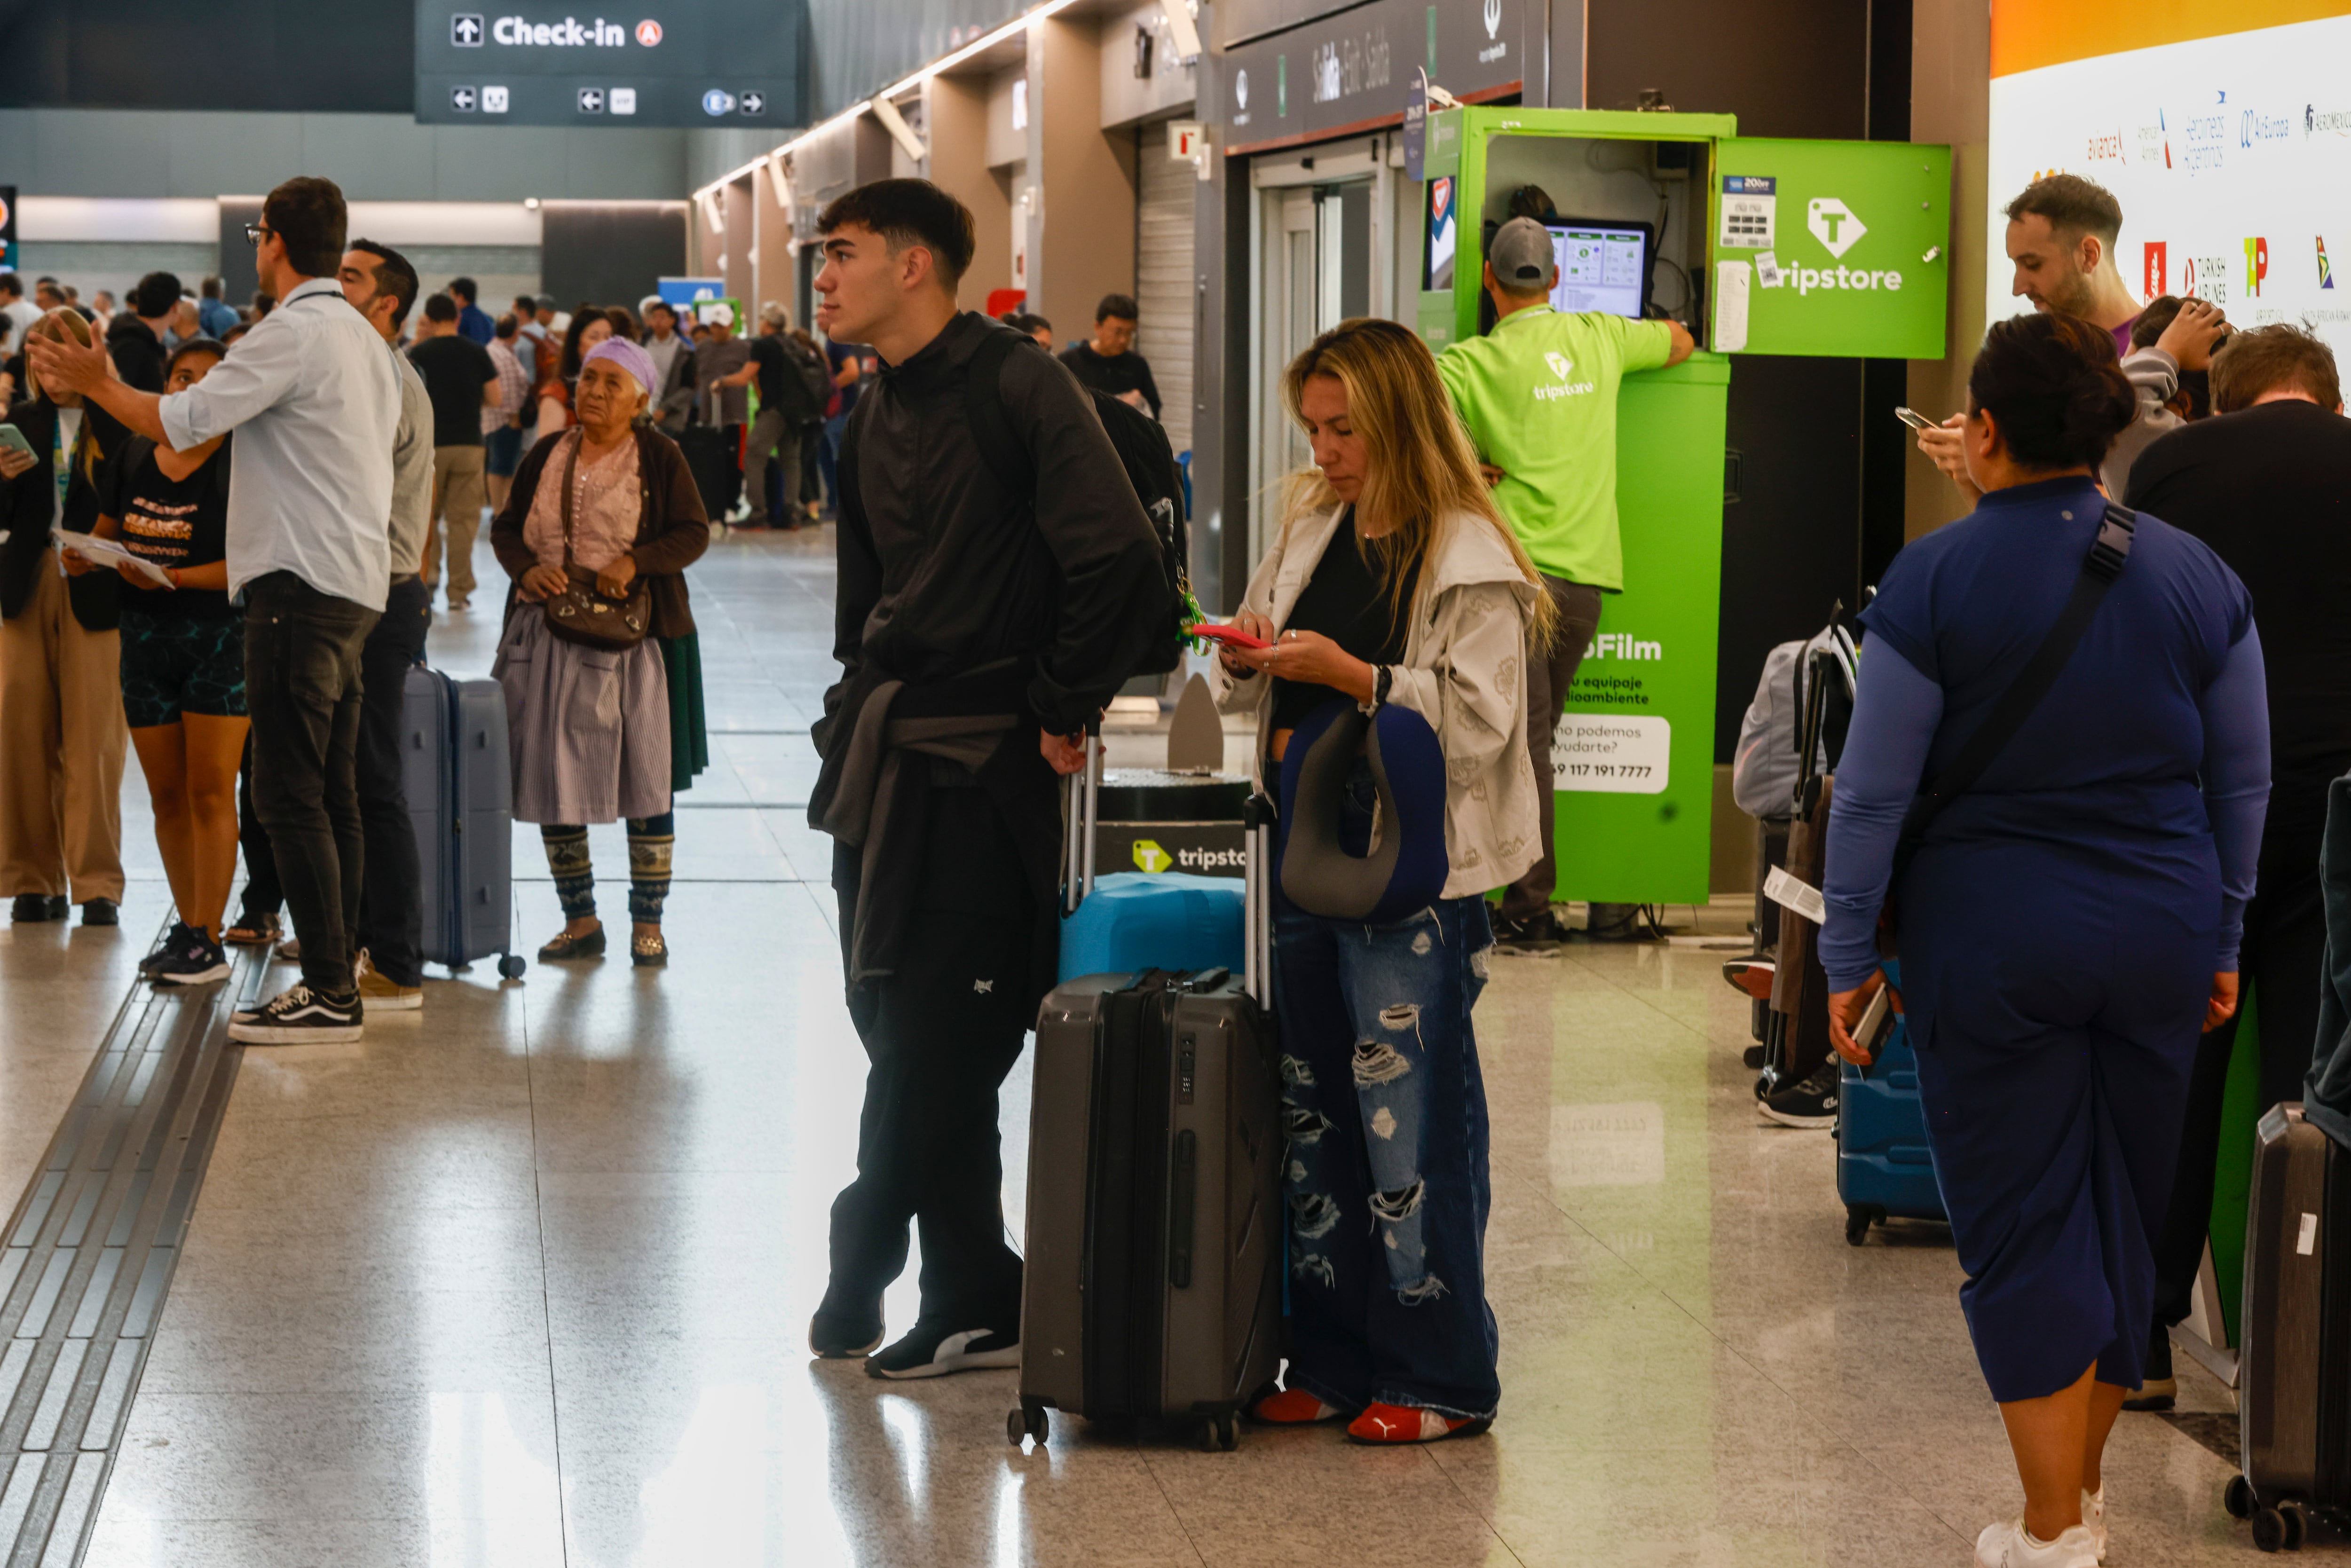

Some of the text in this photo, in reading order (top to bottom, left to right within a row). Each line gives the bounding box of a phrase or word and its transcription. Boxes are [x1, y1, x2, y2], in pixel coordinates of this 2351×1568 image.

[493, 16, 625, 47] Check-in
[2088, 130, 2117, 160] avianca
[1776, 260, 1902, 296] ripstore
[2198, 257, 2226, 277] TURKISH
[2244, 237, 2268, 297] TAP
[2198, 283, 2226, 304] AIRLINES
[1533, 382, 1594, 402] tripstore
[1583, 633, 1662, 660] oFilm
[1571, 676, 1642, 691] u equipaje
[1577, 725, 1641, 738] podemos
[1570, 764, 1590, 775] 117
[1594, 765, 1615, 776] 191
[1619, 766, 1652, 778] 7777
[1178, 847, 1246, 871] tripsto
